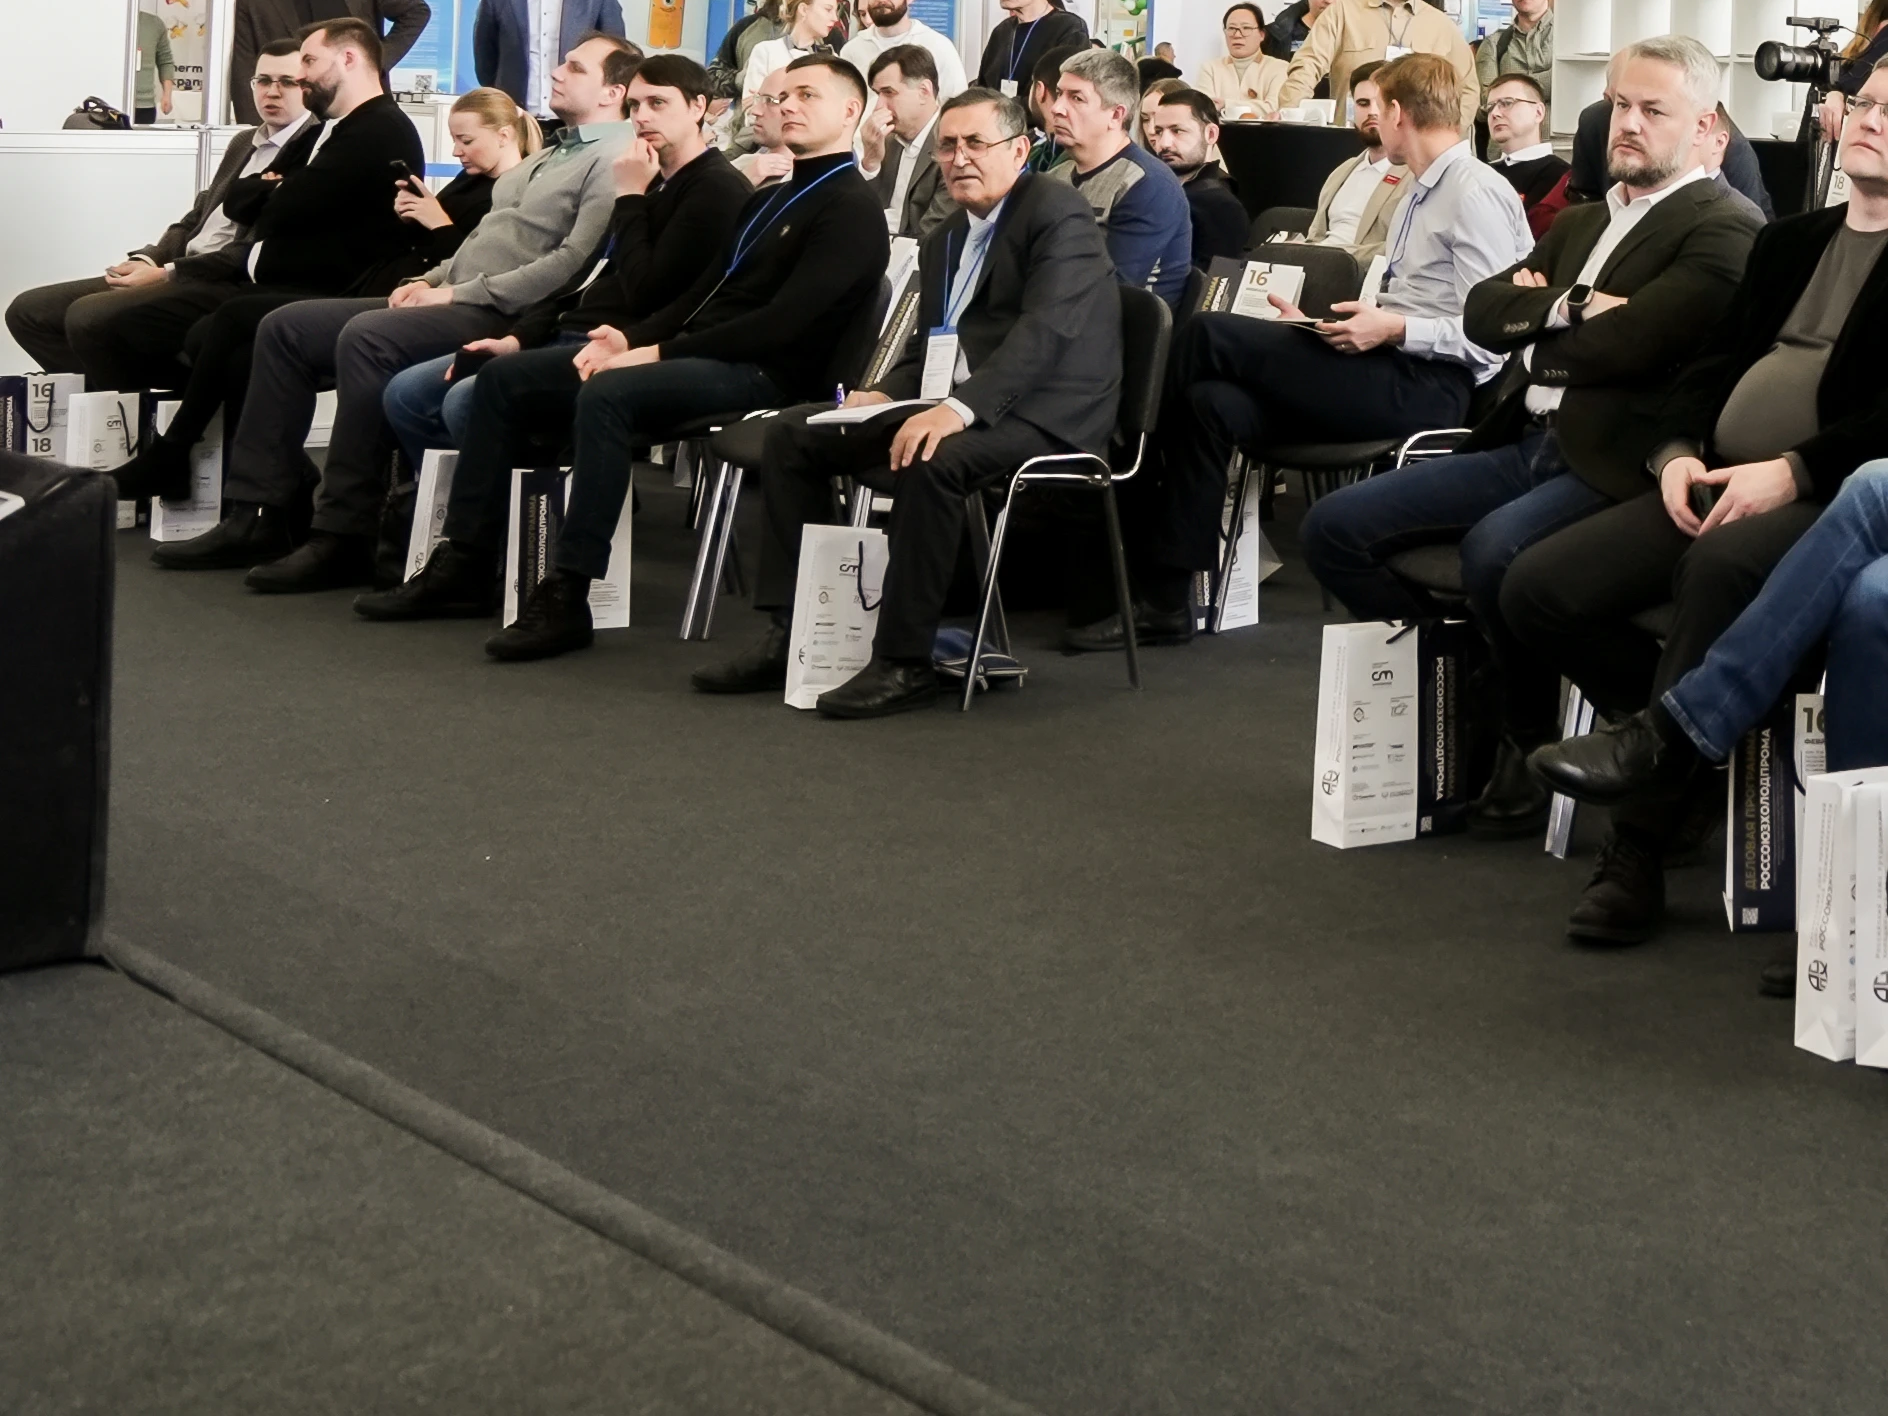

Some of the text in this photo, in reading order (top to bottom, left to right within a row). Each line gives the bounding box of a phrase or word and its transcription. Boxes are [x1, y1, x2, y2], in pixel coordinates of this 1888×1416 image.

[1249, 269, 1269, 286] 16
[31, 437, 52, 453] 18
[1760, 727, 1772, 890] РОССОЮЗХОЛОДПРОМА
[1744, 821, 1757, 891] ДЕЛОВАЯ
